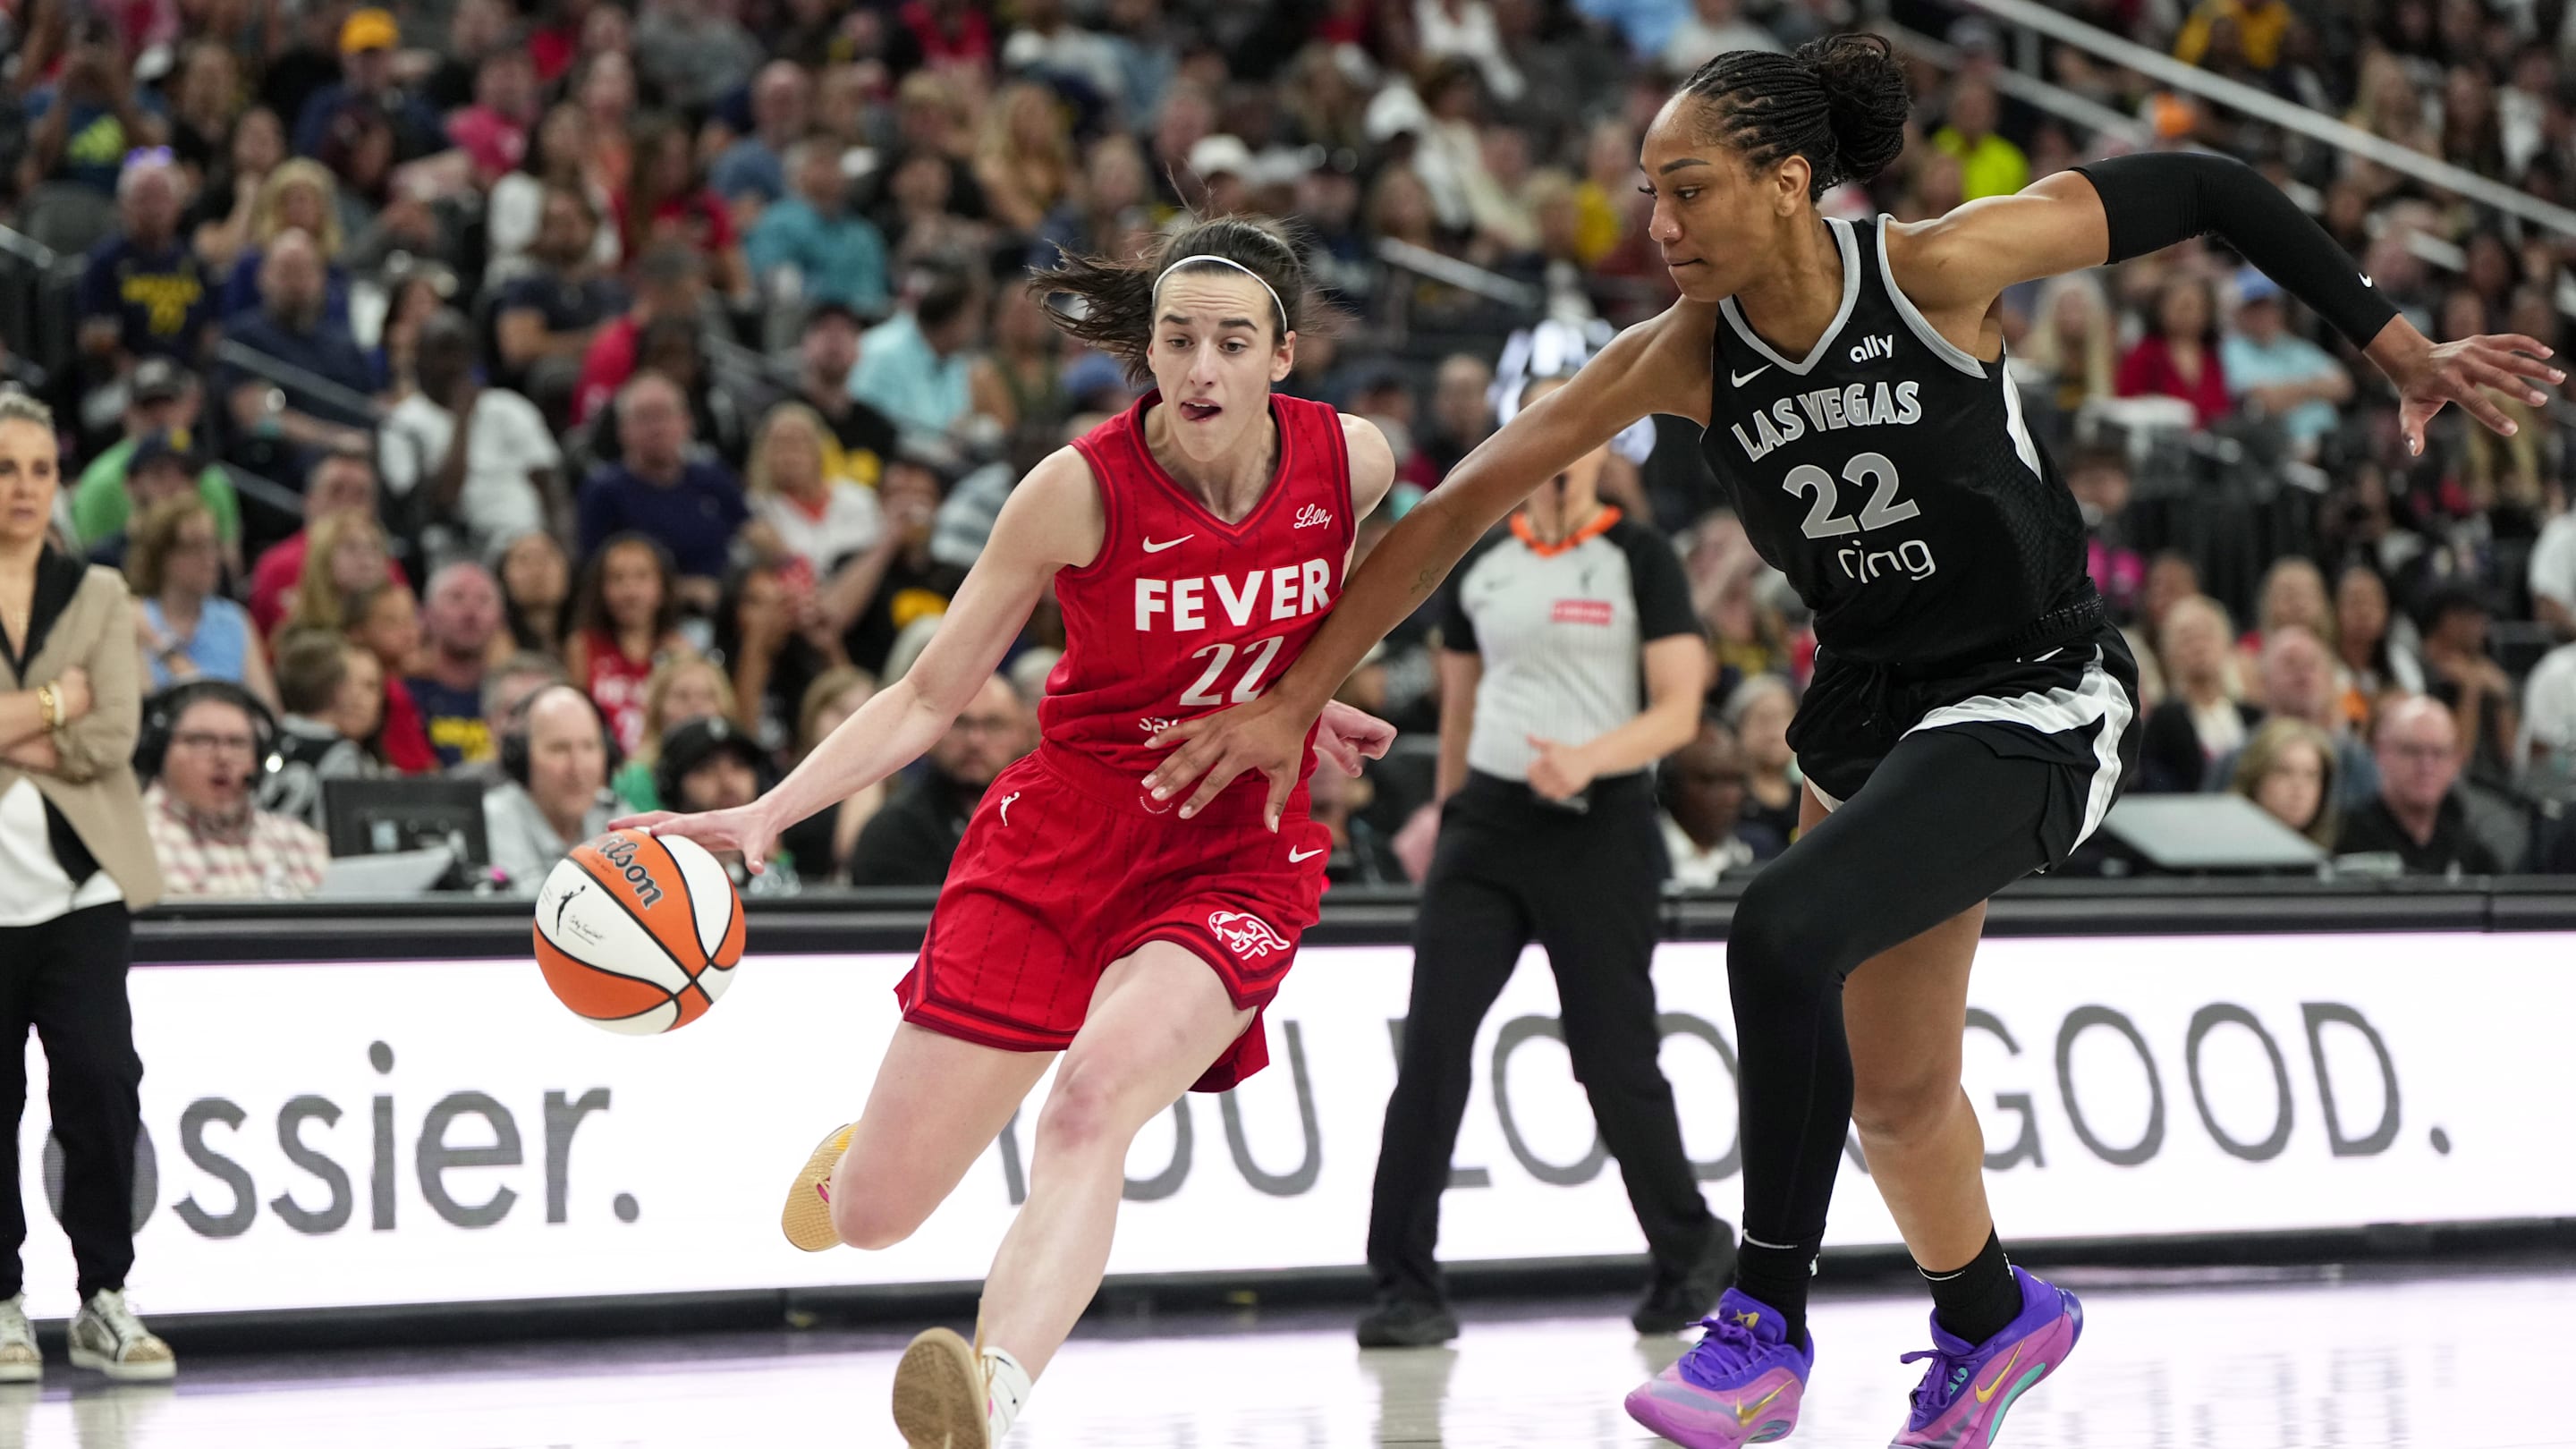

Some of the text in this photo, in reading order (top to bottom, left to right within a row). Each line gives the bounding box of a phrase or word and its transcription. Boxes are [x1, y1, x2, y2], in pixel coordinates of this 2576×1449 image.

[1850, 334, 1894, 363] ally
[1731, 380, 1922, 462] LAS VEGAS
[1293, 503, 1333, 530] Lilly
[1782, 451, 1921, 538] 22
[1134, 557, 1331, 632] FEVER
[1837, 539, 1936, 584] ring
[1178, 635, 1284, 706] 22
[1964, 1002, 2452, 1172] GOOD.
